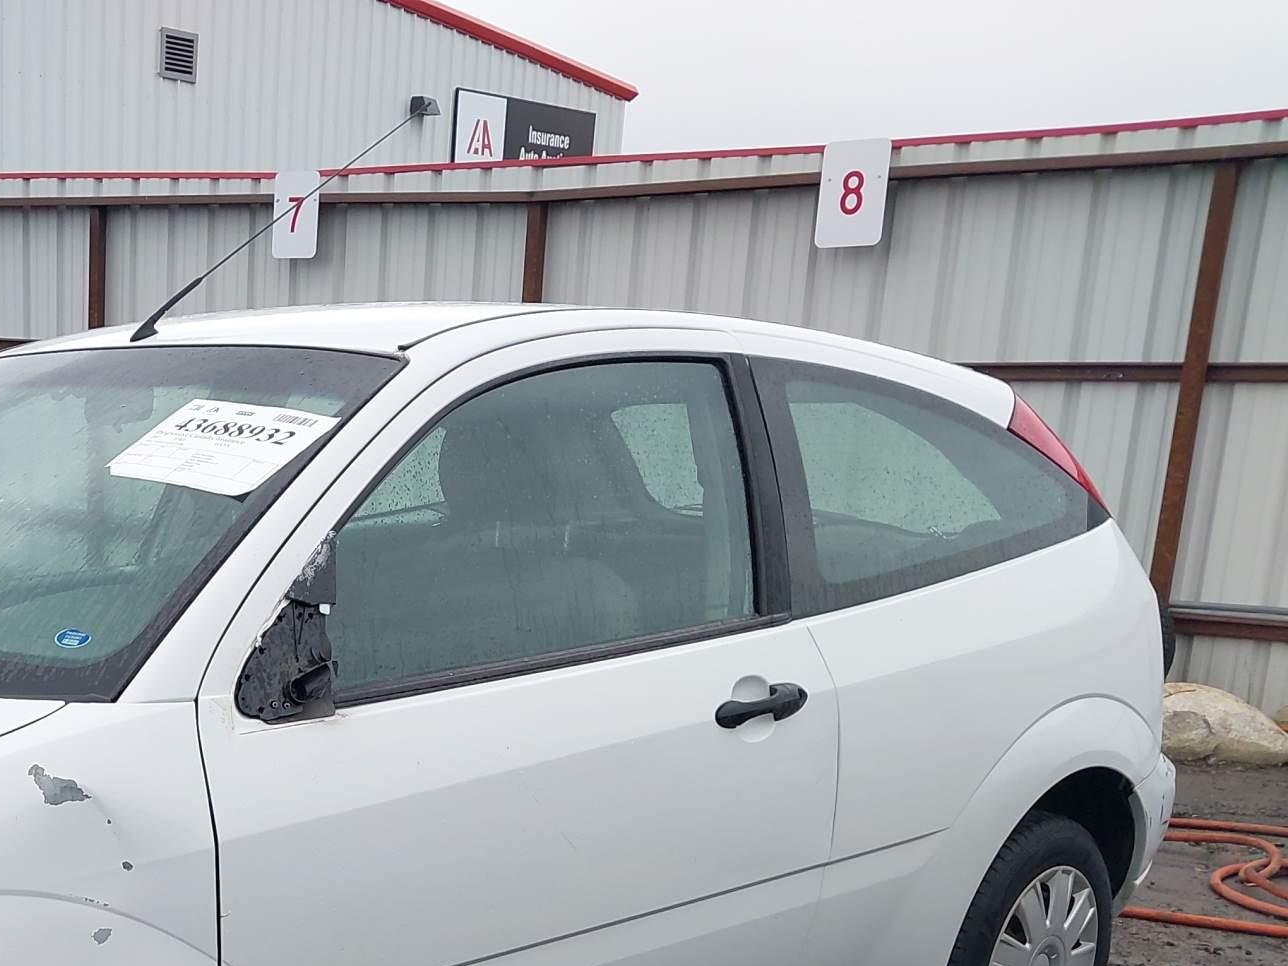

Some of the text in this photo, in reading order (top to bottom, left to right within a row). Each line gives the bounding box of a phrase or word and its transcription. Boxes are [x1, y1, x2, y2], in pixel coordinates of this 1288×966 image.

[528, 124, 570, 150] Insurance
[839, 170, 865, 215] 8
[288, 196, 305, 233] 7
[175, 416, 297, 446] 43688932
